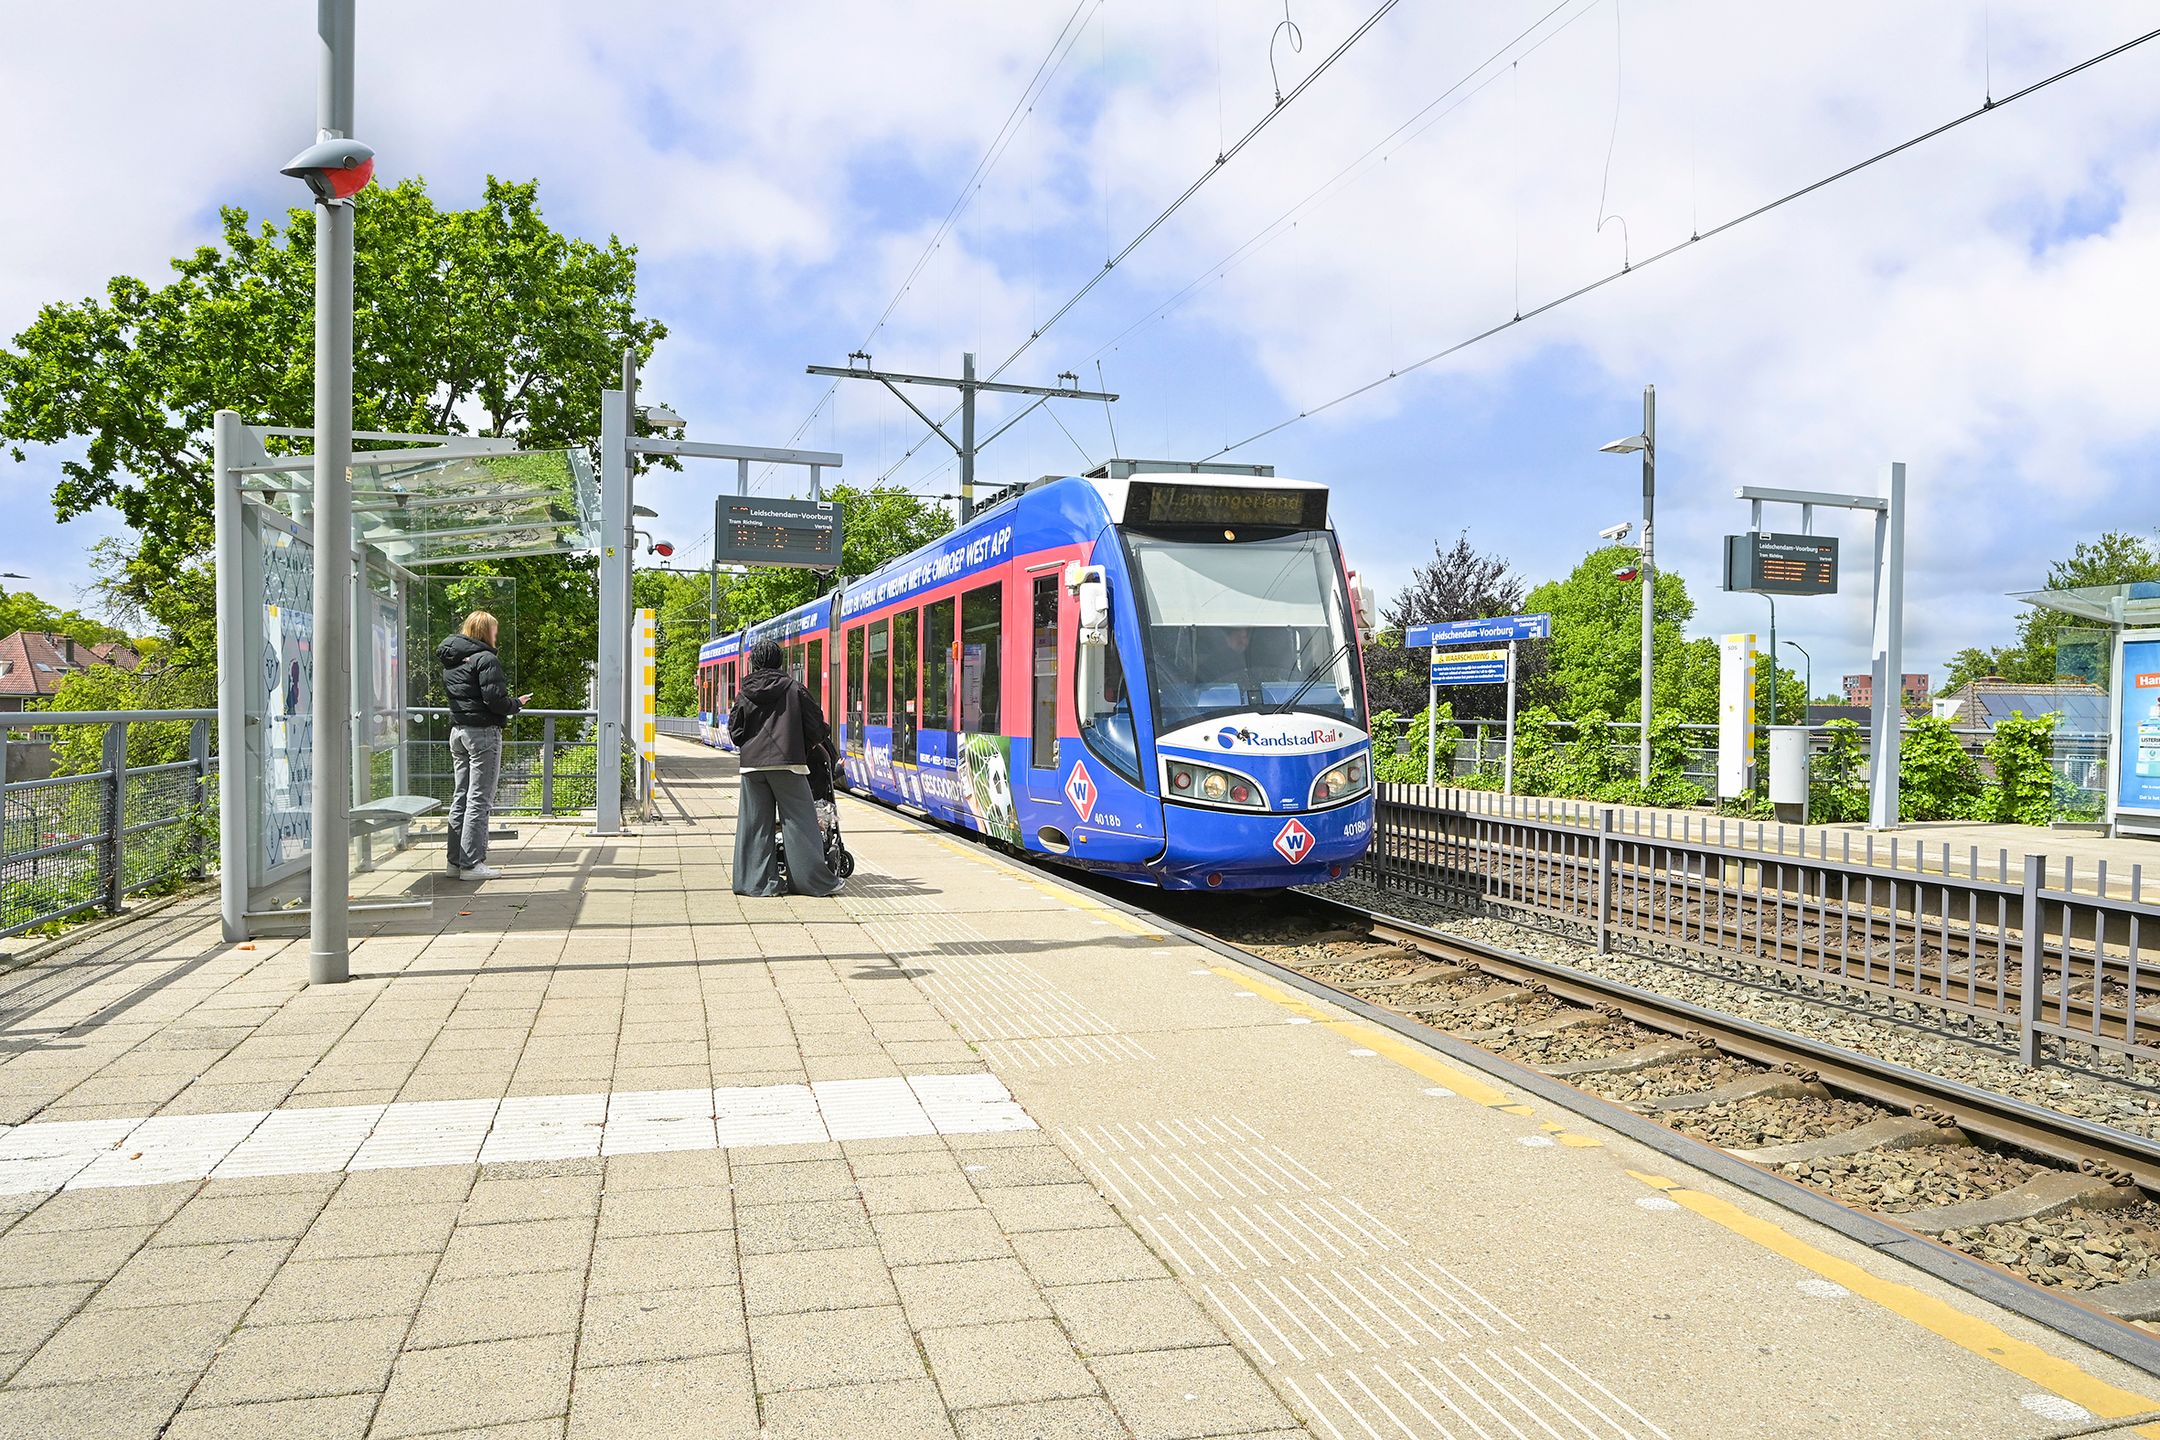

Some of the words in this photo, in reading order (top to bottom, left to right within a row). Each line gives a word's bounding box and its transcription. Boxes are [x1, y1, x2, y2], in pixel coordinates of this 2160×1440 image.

[743, 519, 763, 527] Richting
[750, 509, 833, 523] Leidschendam-Voorburg
[1759, 543, 1819, 554] Leidschendam-Voorburg
[908, 566, 923, 591] MET
[922, 561, 933, 586] DE
[932, 546, 966, 581] OMROEP
[966, 534, 991, 568] WEST
[990, 526, 1012, 558] APP
[1431, 626, 1514, 641] Leidschendam-Voorburg
[1445, 652, 1490, 662] WAARSCHUWING
[1246, 729, 1336, 746] RandstadRail
[872, 744, 890, 769] west
[1073, 782, 1087, 801] W
[1094, 812, 1121, 827] 4018b
[1343, 819, 1367, 837] 4018b
[1285, 834, 1304, 850] W
